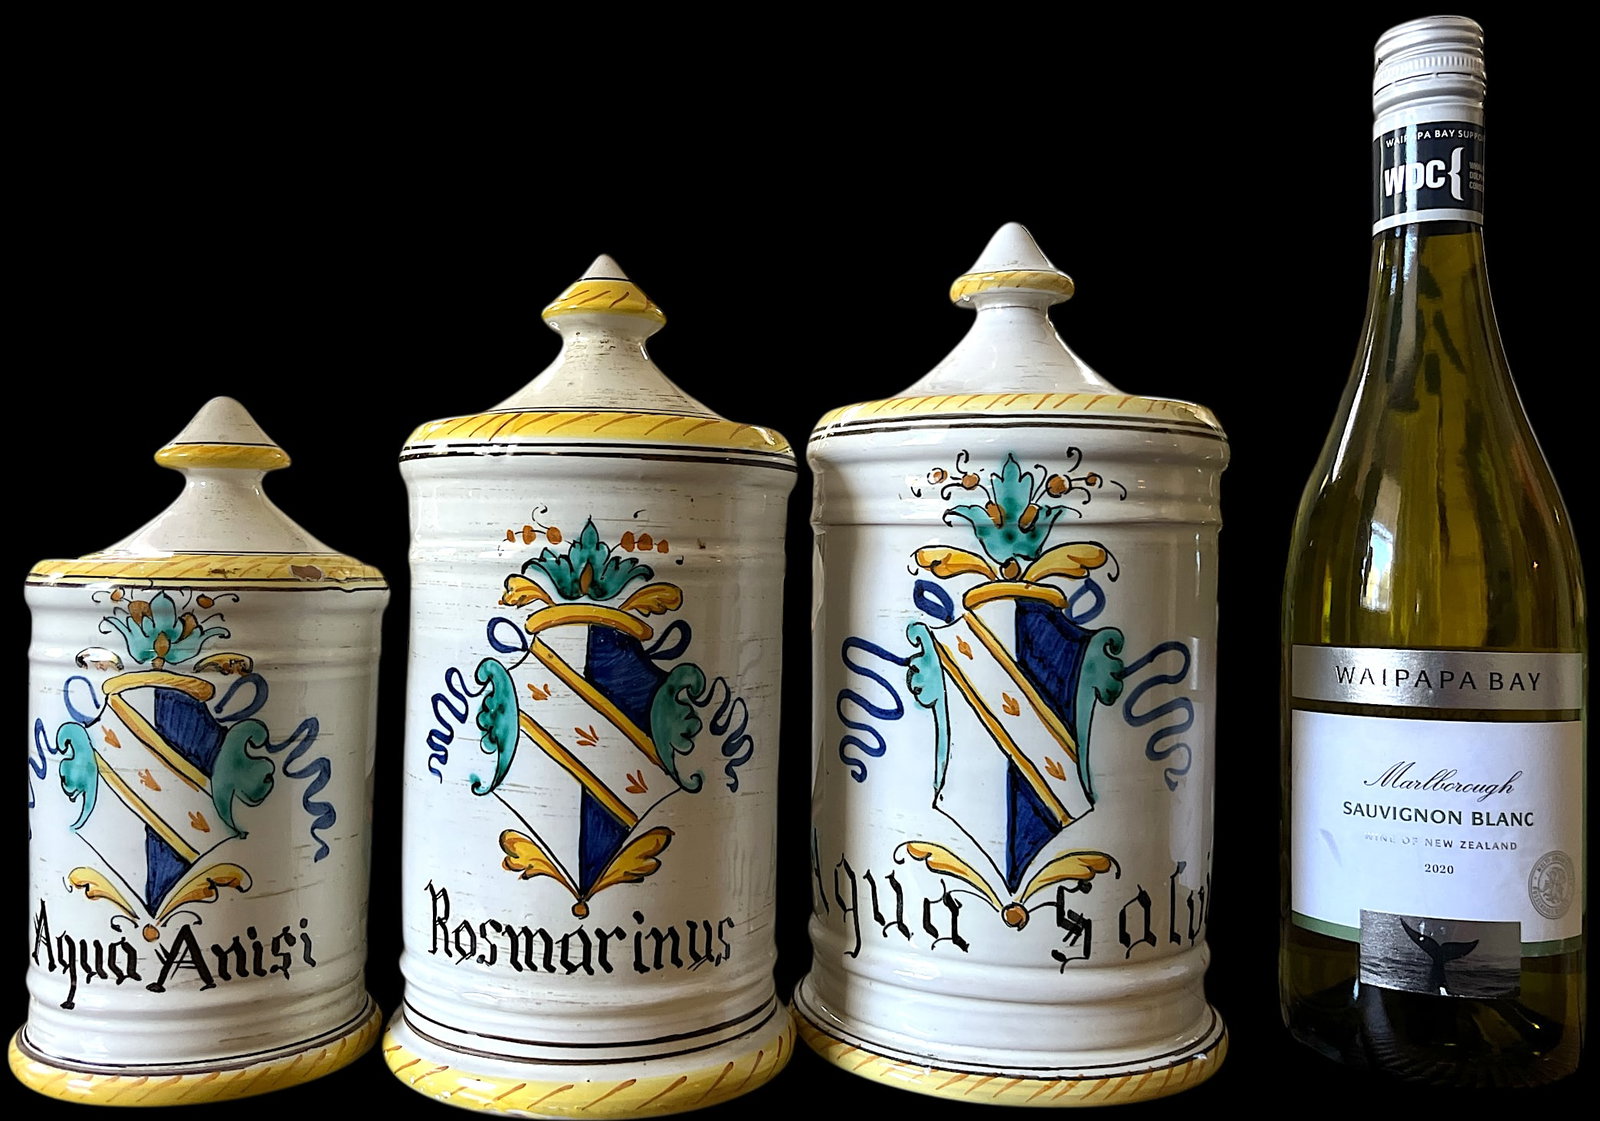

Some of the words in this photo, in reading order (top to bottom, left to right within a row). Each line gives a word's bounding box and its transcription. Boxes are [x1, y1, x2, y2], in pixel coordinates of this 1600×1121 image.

[1386, 132, 1430, 147] WAIPPA
[1435, 130, 1454, 138] BAY
[1334, 665, 1477, 690] WAIPAPA
[1489, 671, 1541, 691] BAY
[1363, 760, 1523, 803] Marlborough
[1342, 800, 1463, 826] SAUVIGNON
[1470, 811, 1535, 827] BLANC
[1364, 832, 1396, 844] WINE
[1401, 835, 1419, 846] OF
[1424, 837, 1454, 849] NEW
[1459, 840, 1518, 851] ZEALAND
[1424, 863, 1455, 875] 2020
[424, 879, 736, 977] Rosmarinus
[146, 917, 317, 993] Anisi
